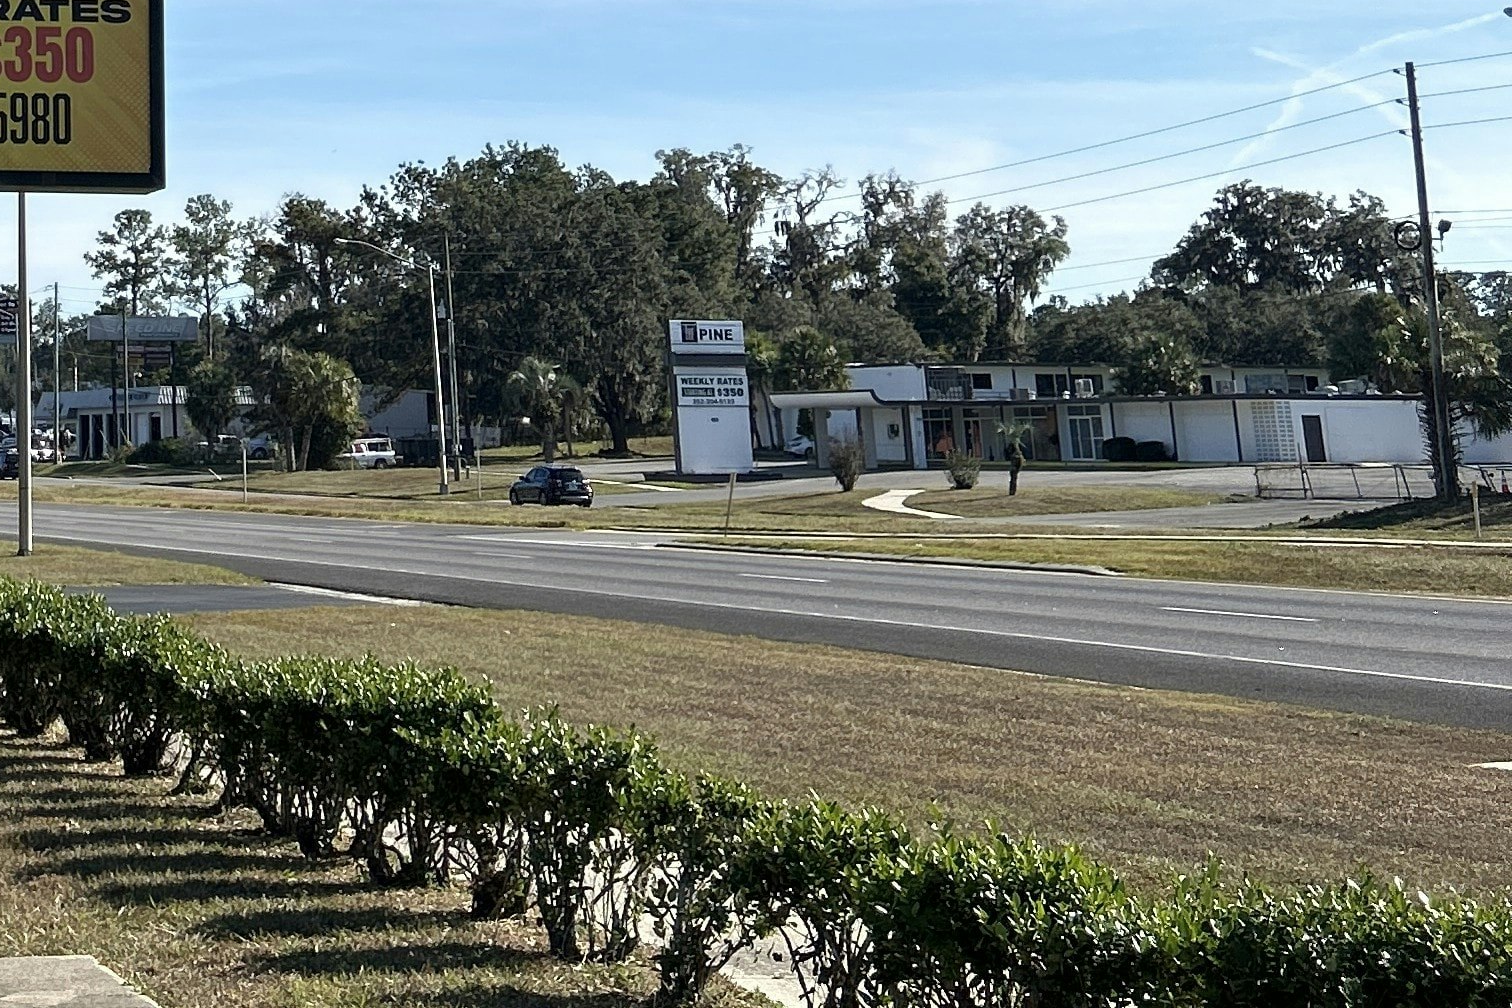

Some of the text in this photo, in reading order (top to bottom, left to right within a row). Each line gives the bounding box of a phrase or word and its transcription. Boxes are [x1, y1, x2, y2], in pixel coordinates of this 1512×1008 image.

[699, 328, 733, 341] PINE
[680, 377, 744, 386] WEEKLY RATES
[717, 387, 744, 397] $350
